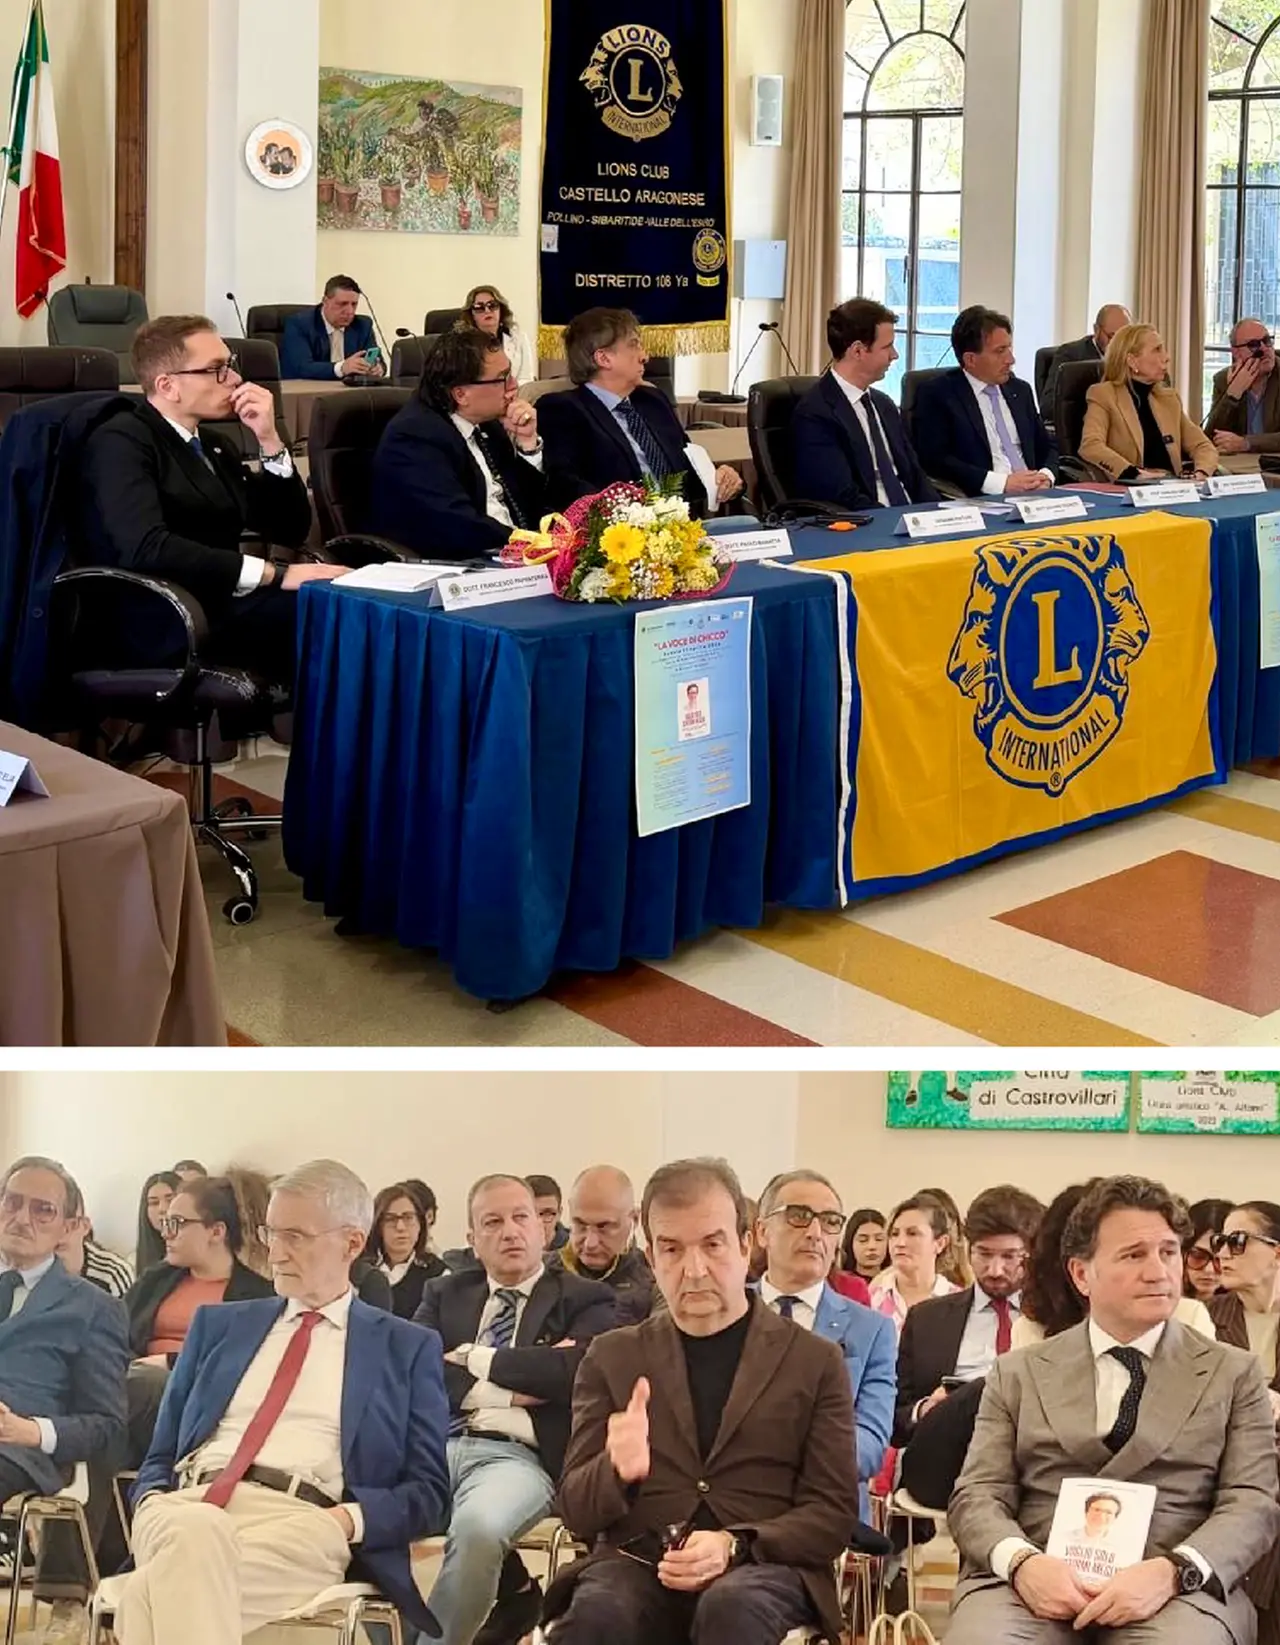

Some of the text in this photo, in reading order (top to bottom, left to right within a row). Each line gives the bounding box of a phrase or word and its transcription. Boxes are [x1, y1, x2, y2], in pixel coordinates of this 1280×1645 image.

[609, 27, 667, 56] LIONS
[628, 58, 652, 101] L
[607, 110, 668, 135] INTERNATIONAL
[598, 162, 669, 179] LIONS CLUB
[559, 187, 705, 206] CASTELLO ARAGONESE
[547, 211, 584, 224] POLLINO
[591, 215, 643, 226] SIBARITIDE
[575, 273, 651, 288] DISTRETTO
[1032, 590, 1082, 689] L
[998, 709, 1110, 771] INTERNATIONAL
[979, 1087, 1117, 1106] di Castrovillari
